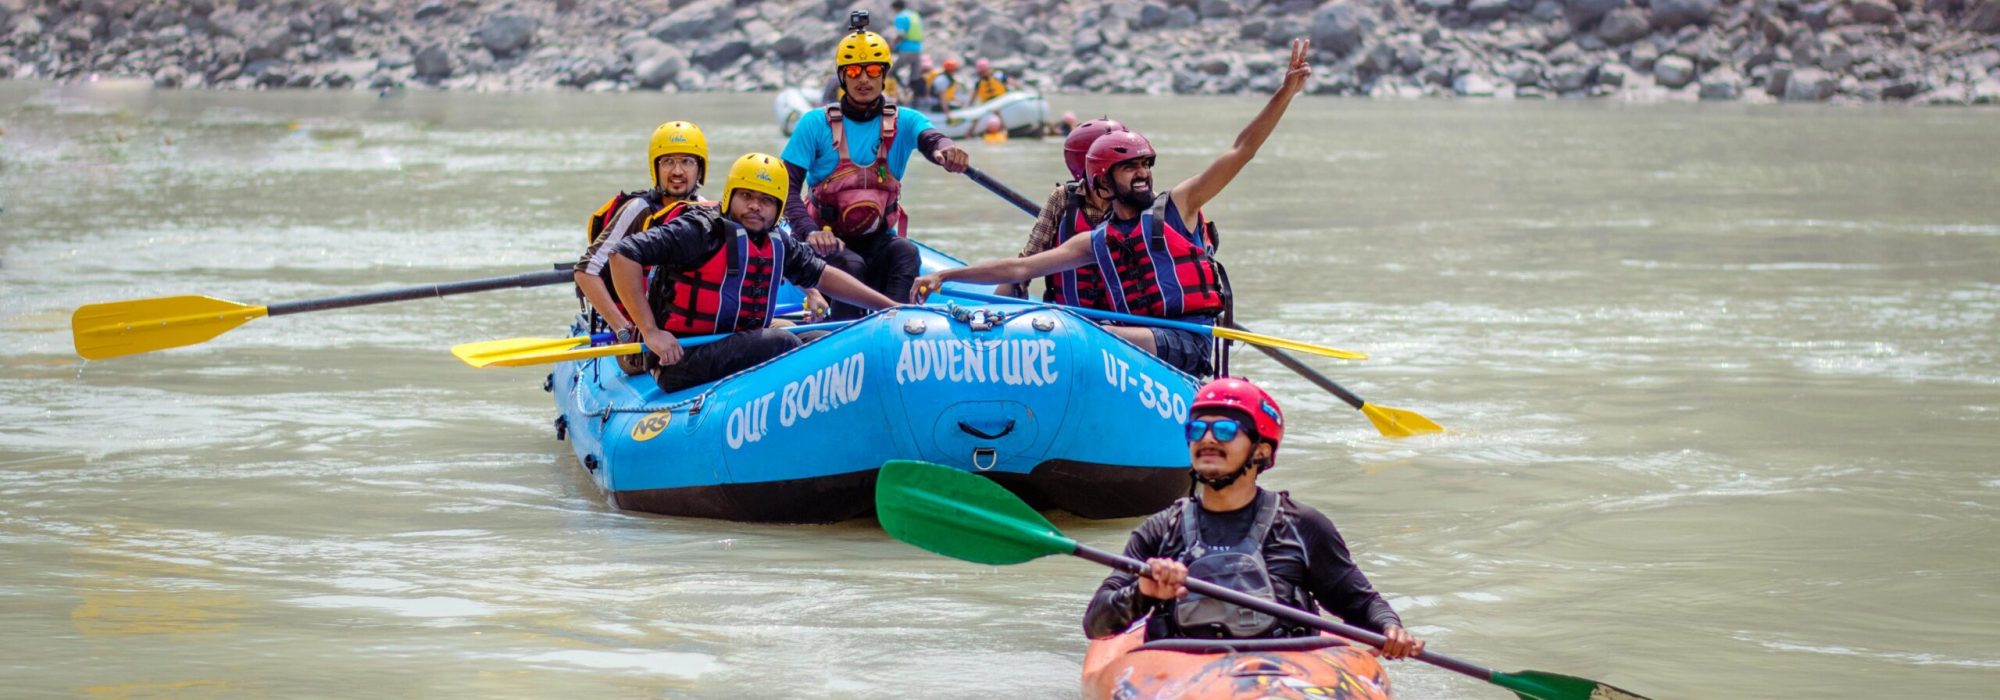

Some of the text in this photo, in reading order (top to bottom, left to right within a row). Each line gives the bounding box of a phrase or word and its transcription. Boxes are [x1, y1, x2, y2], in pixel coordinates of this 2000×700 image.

[632, 413, 670, 437] NRS
[726, 338, 1059, 450] OUT BOUND ADVENTURE
[1101, 348, 1187, 425] UT-330
